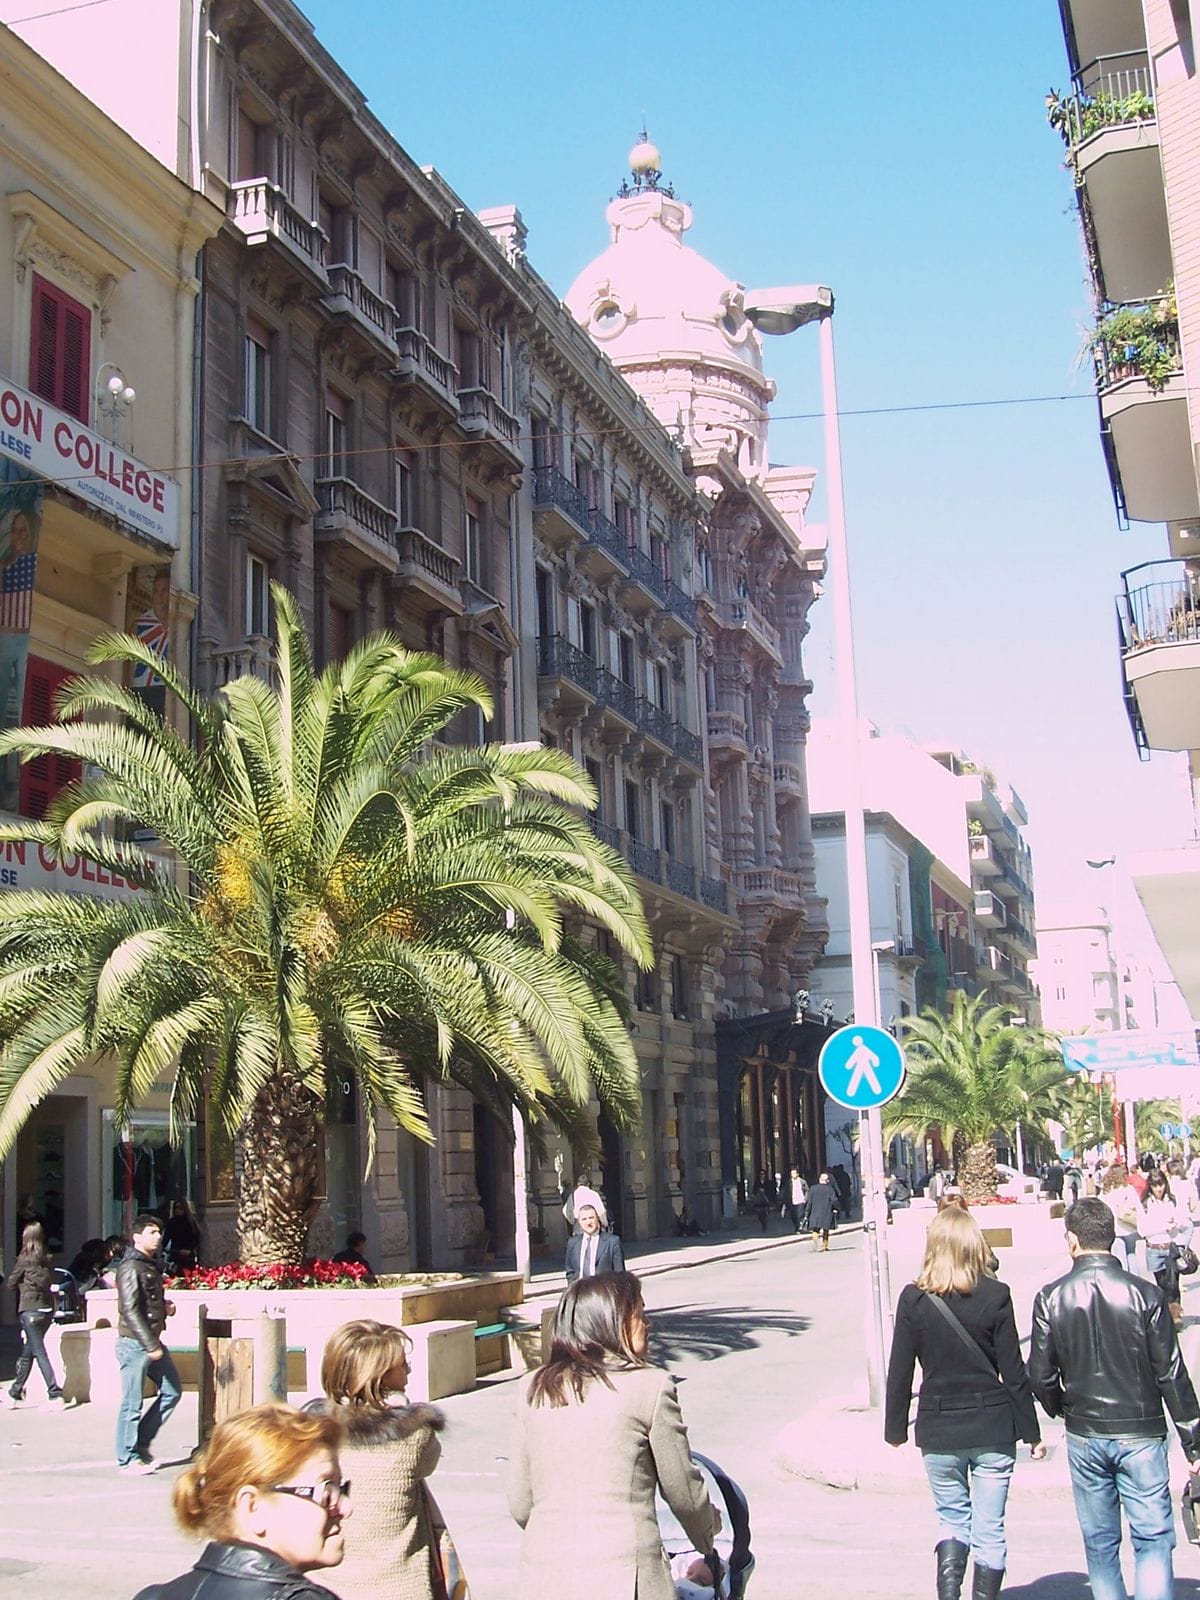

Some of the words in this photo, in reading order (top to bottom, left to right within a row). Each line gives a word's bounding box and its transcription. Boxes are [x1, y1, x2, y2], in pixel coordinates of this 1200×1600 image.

[1, 430, 32, 460] LESE
[1, 390, 43, 443] ON
[54, 422, 165, 513] COLLEGE
